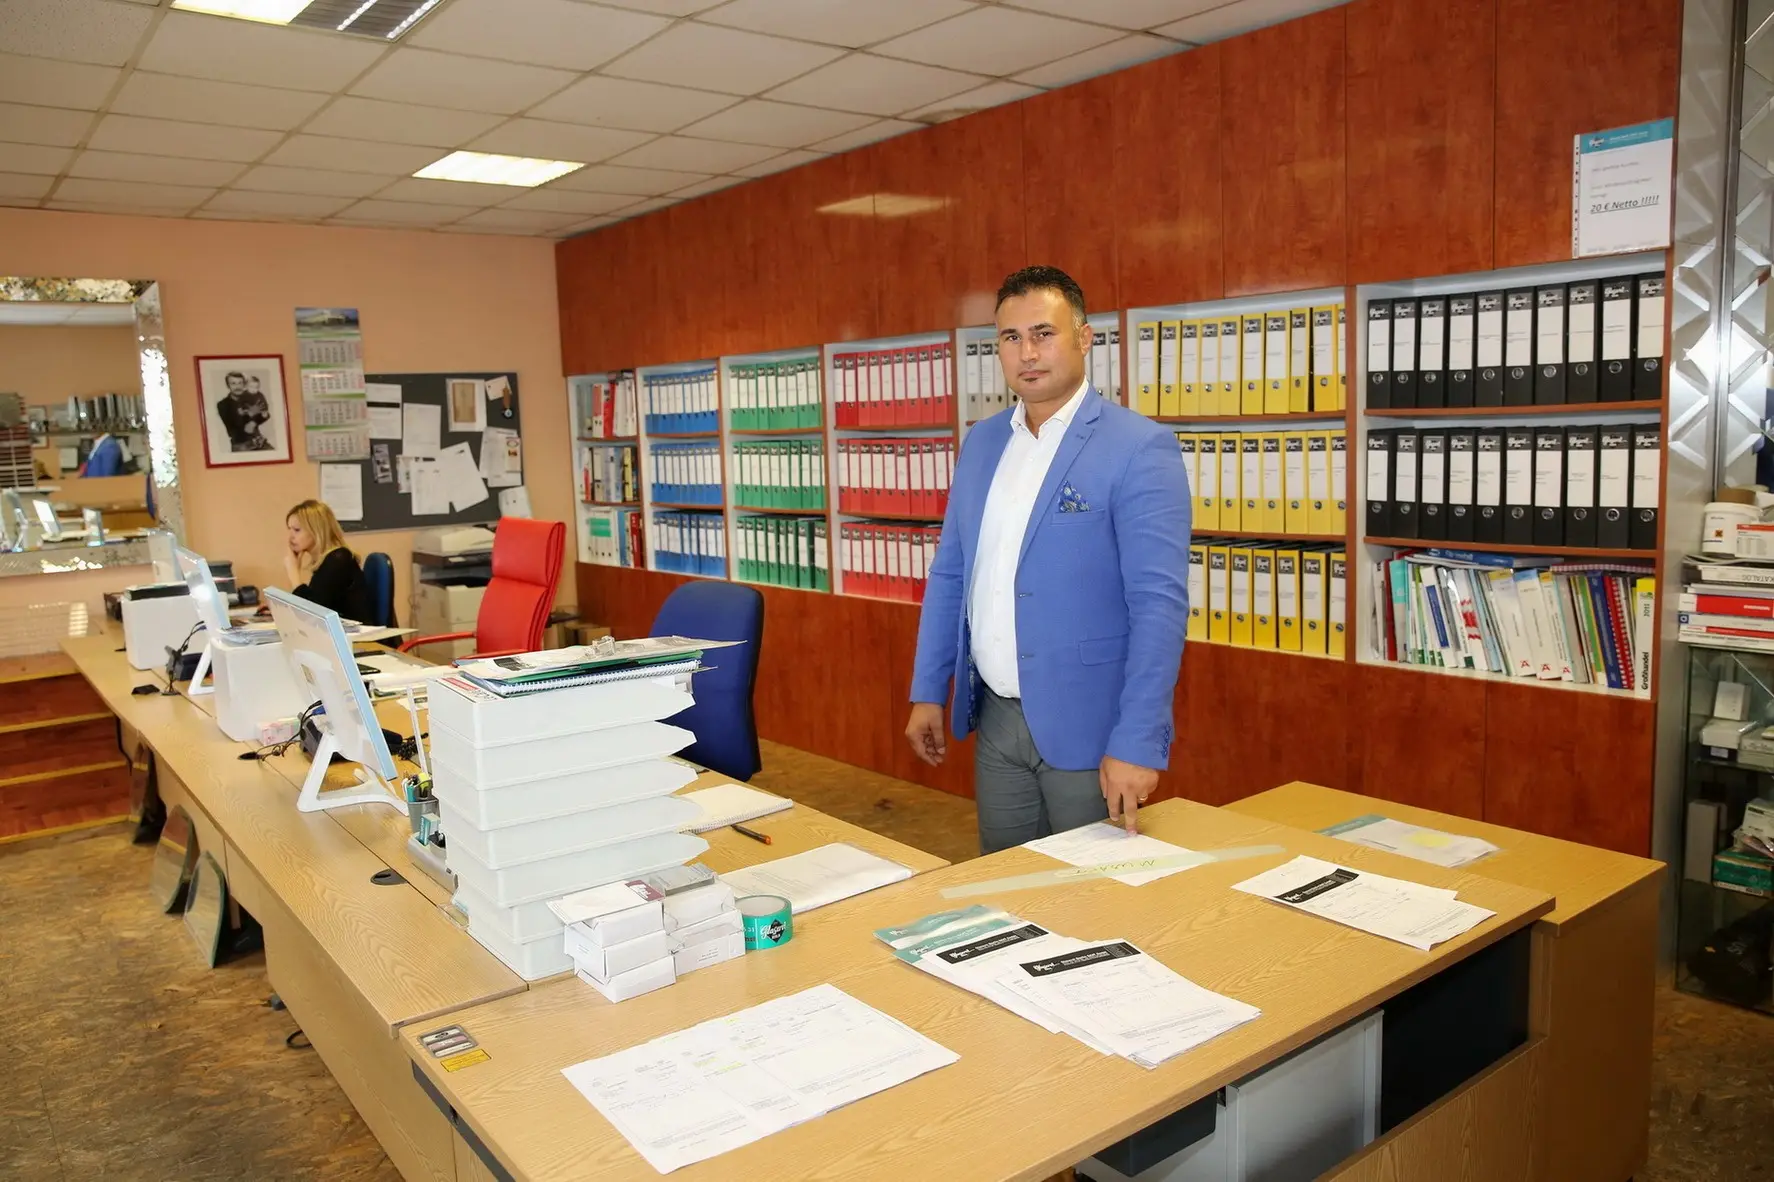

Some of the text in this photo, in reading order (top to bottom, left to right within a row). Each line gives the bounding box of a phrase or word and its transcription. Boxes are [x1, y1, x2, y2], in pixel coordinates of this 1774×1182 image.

[1590, 204, 1602, 213] 20
[1604, 203, 1610, 211] €
[1612, 200, 1639, 209] Netto
[1641, 652, 1649, 690] Großhandel
